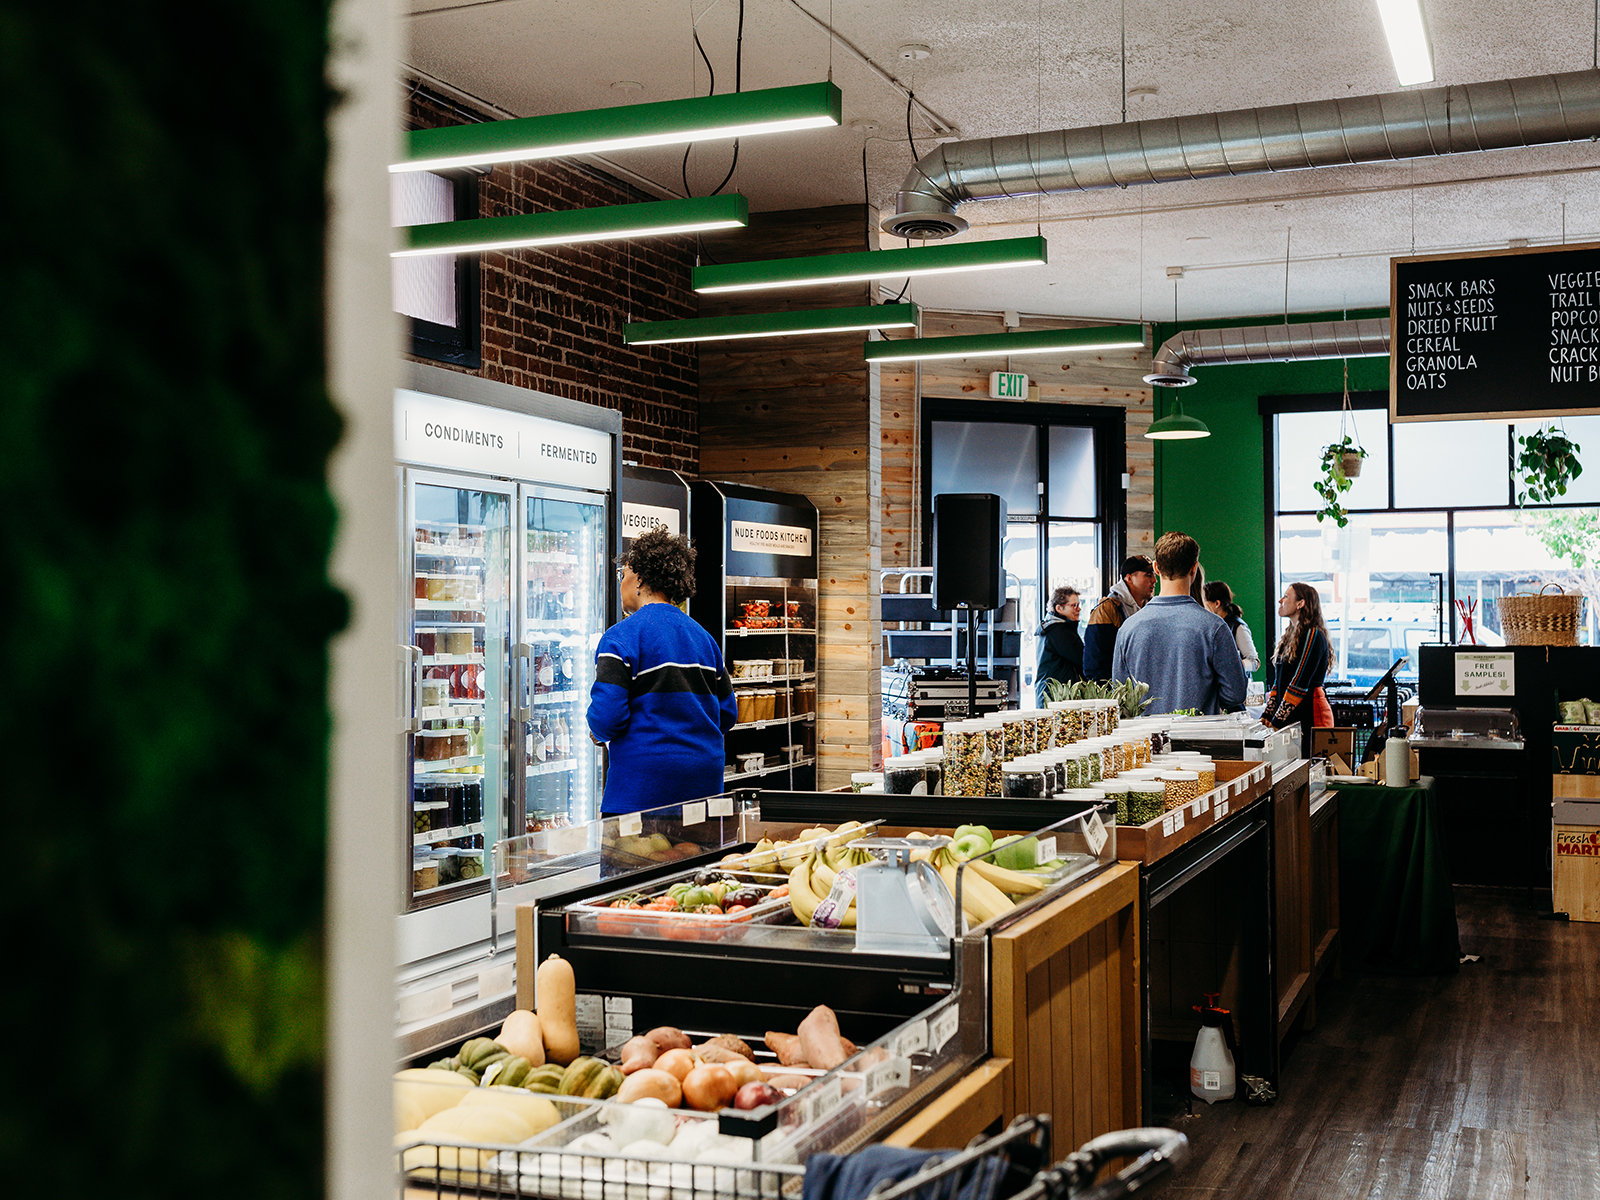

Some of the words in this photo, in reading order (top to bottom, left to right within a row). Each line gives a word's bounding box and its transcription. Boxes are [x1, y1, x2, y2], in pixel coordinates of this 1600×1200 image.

[1408, 282, 1454, 299] SNACK
[1461, 279, 1496, 296] BARS
[1548, 271, 1600, 290] VEGGIE
[1408, 301, 1442, 317] NUTS
[1445, 303, 1451, 312] &
[1454, 298, 1494, 314] SEEDS
[1549, 292, 1592, 308] TRAIL
[1408, 318, 1451, 335] DRIED
[1455, 315, 1498, 333] FRUIT
[1552, 309, 1600, 327] POPCO
[1407, 336, 1460, 353] CEREAL
[1551, 328, 1599, 346] SNACK
[1406, 354, 1477, 372] GRANOLA
[1549, 347, 1598, 364] CRACK
[1407, 373, 1446, 390] OATS
[1551, 366, 1583, 383] NUT
[1589, 365, 1600, 382] B
[998, 373, 1024, 397] EXIT
[424, 422, 504, 449] CONDIMENTS
[540, 443, 597, 465] FERMENTED
[623, 513, 660, 529] VEGGIES
[735, 527, 754, 538] NUDE
[756, 529, 779, 541] FOODS
[780, 532, 808, 544] KITCHEN
[1557, 833, 1590, 844] Fresh
[1557, 843, 1600, 856] MART
